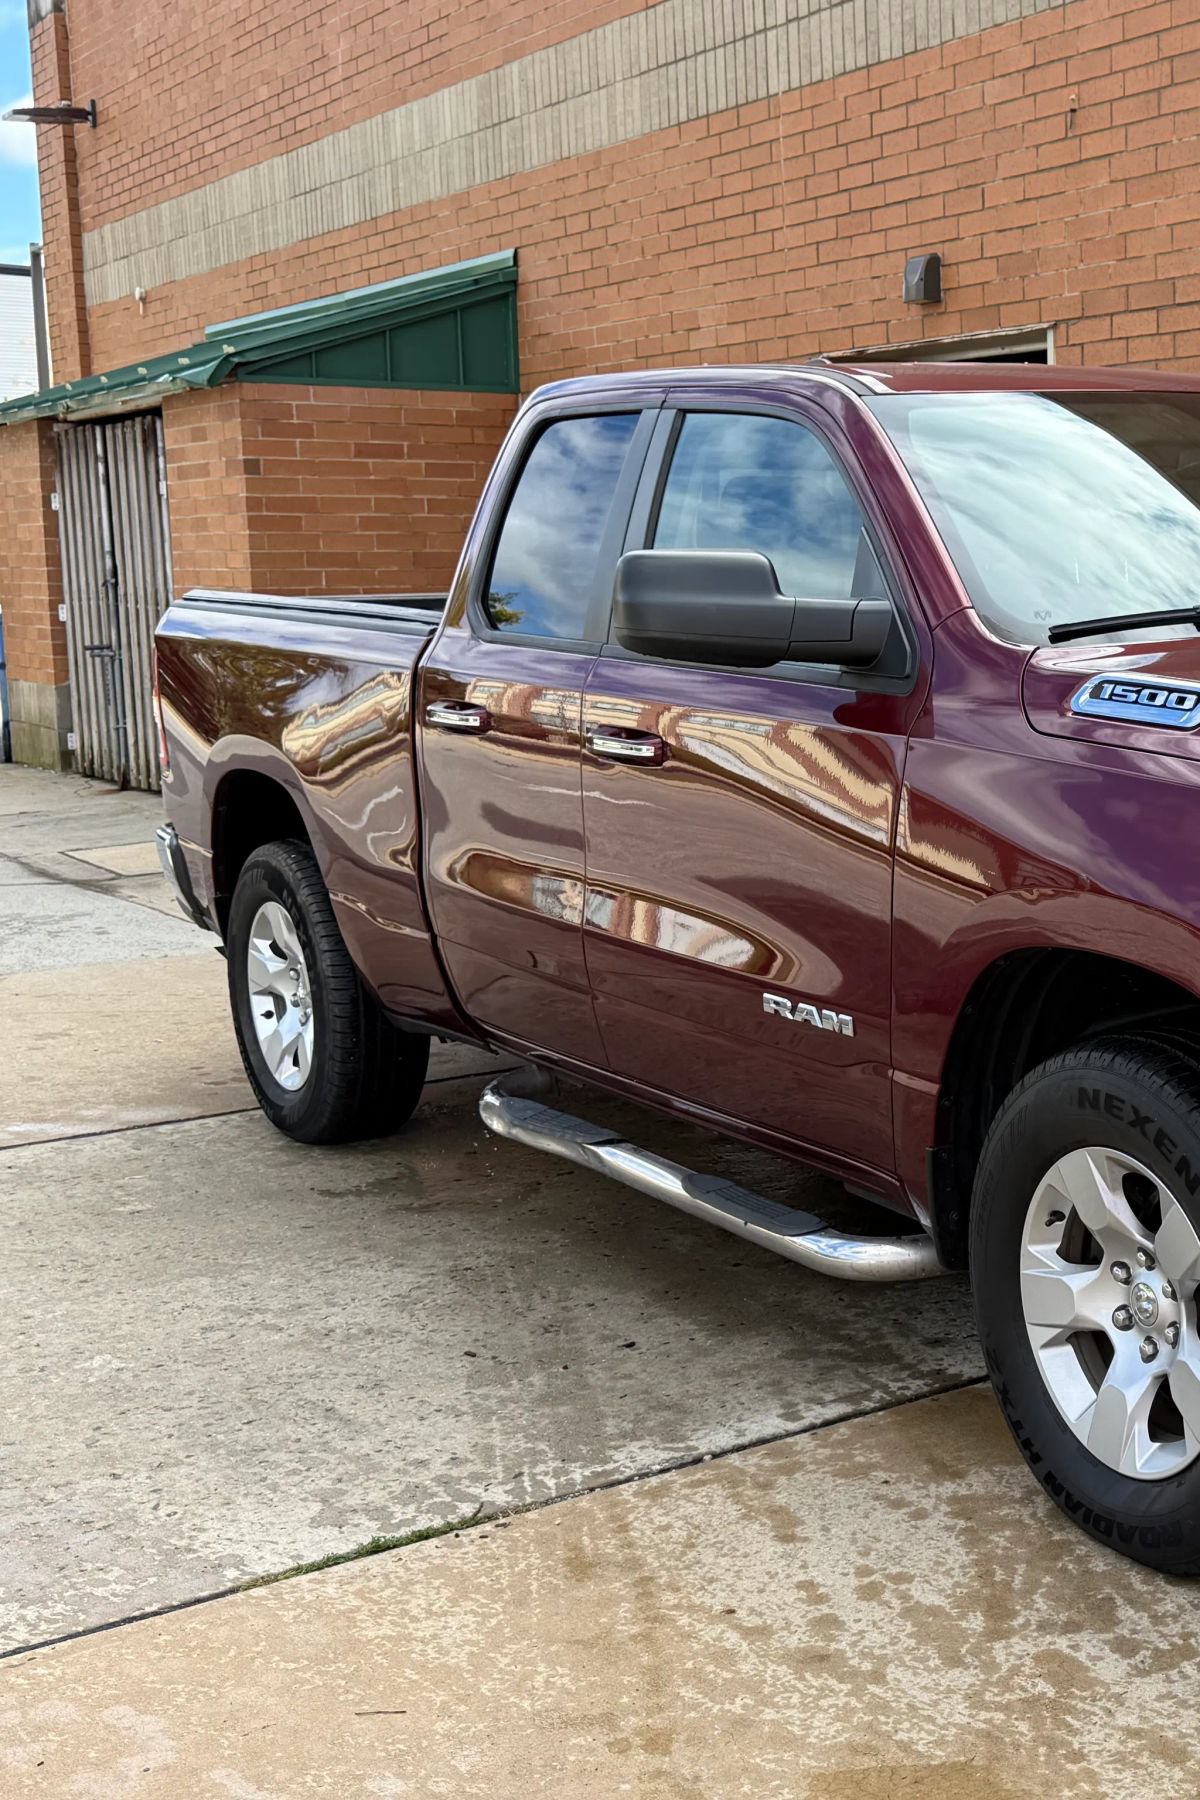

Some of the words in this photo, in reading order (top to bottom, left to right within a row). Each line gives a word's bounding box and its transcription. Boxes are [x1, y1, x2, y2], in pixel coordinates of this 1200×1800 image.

[1100, 683, 1198, 710] 1500
[762, 992, 856, 1037] RAM
[1043, 1470, 1182, 1548] ROADIAN
